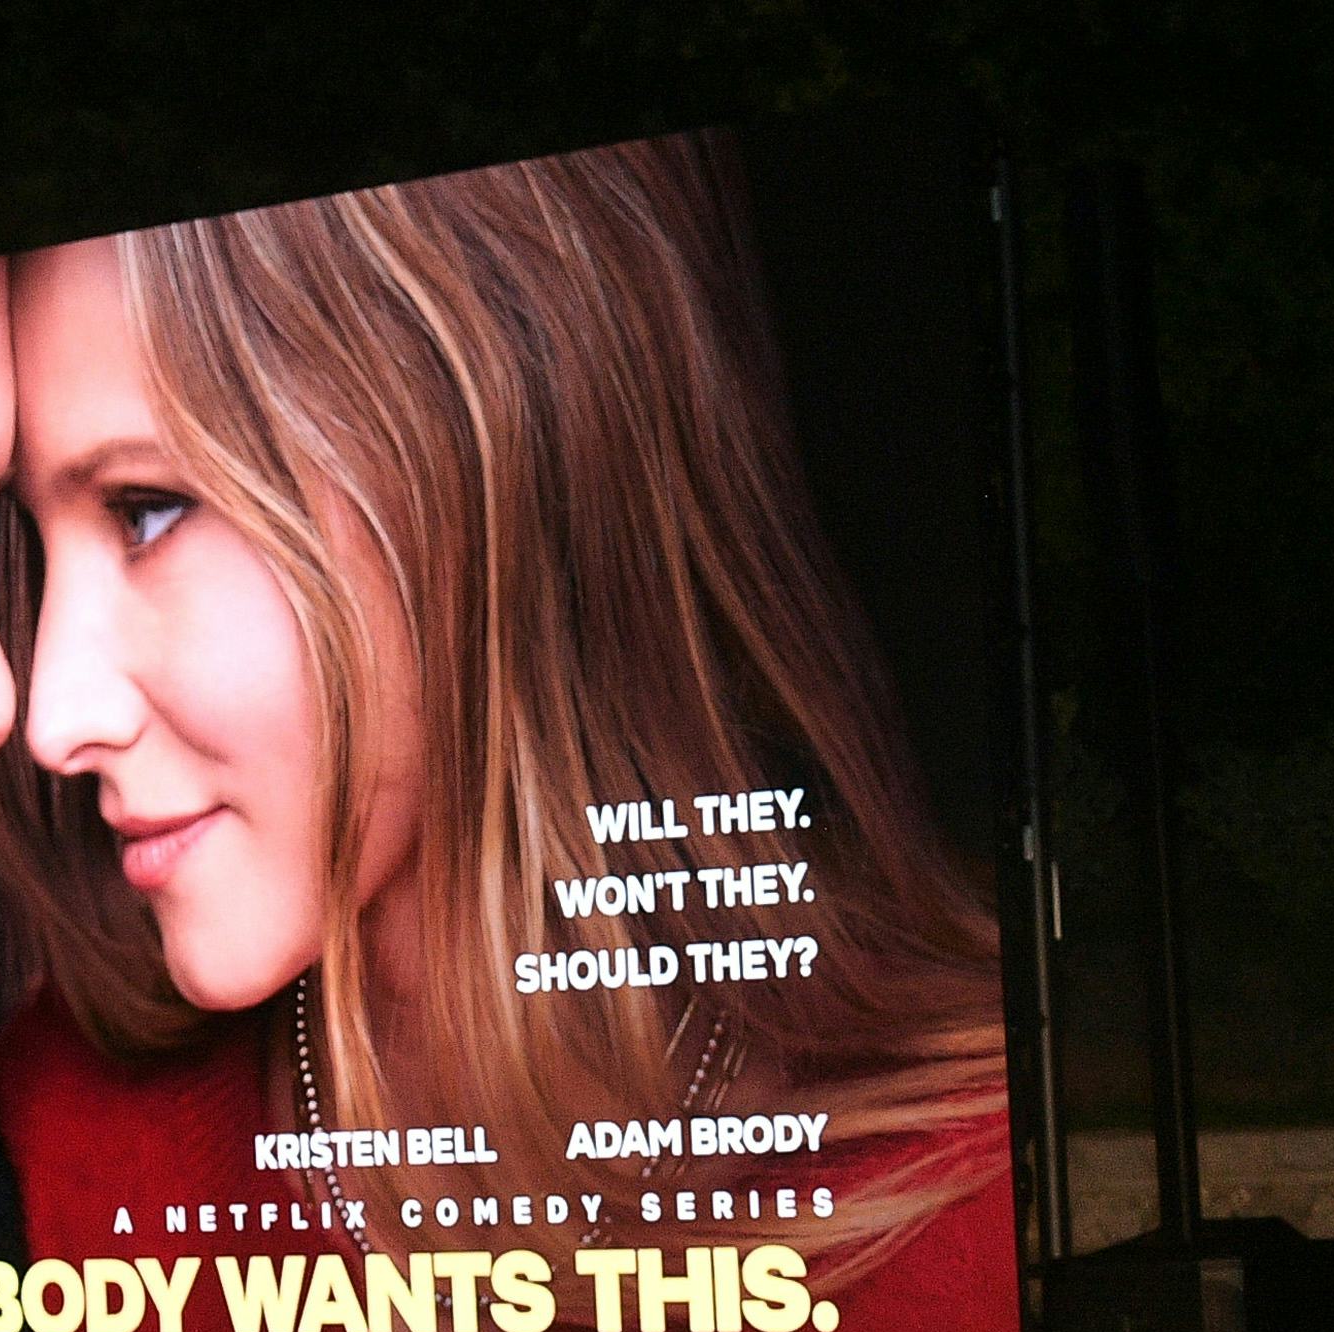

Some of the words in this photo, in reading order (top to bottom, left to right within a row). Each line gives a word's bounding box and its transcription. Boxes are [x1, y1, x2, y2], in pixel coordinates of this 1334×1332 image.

[585, 799, 688, 844] WILL
[694, 788, 811, 836] THEY.
[554, 871, 690, 918] WON'T
[697, 862, 815, 909] THEY.
[514, 945, 679, 994] SHOULD
[685, 936, 819, 983] THEY?
[254, 1128, 400, 1170] KRISTEN
[406, 1125, 498, 1165] BELL
[566, 1119, 682, 1160] ADAM
[689, 1113, 828, 1156] BRODY
[113, 1206, 133, 1234] A
[165, 1200, 366, 1234] NETFLIX
[401, 1194, 602, 1228] COMEDY
[641, 1188, 835, 1222] SERIES
